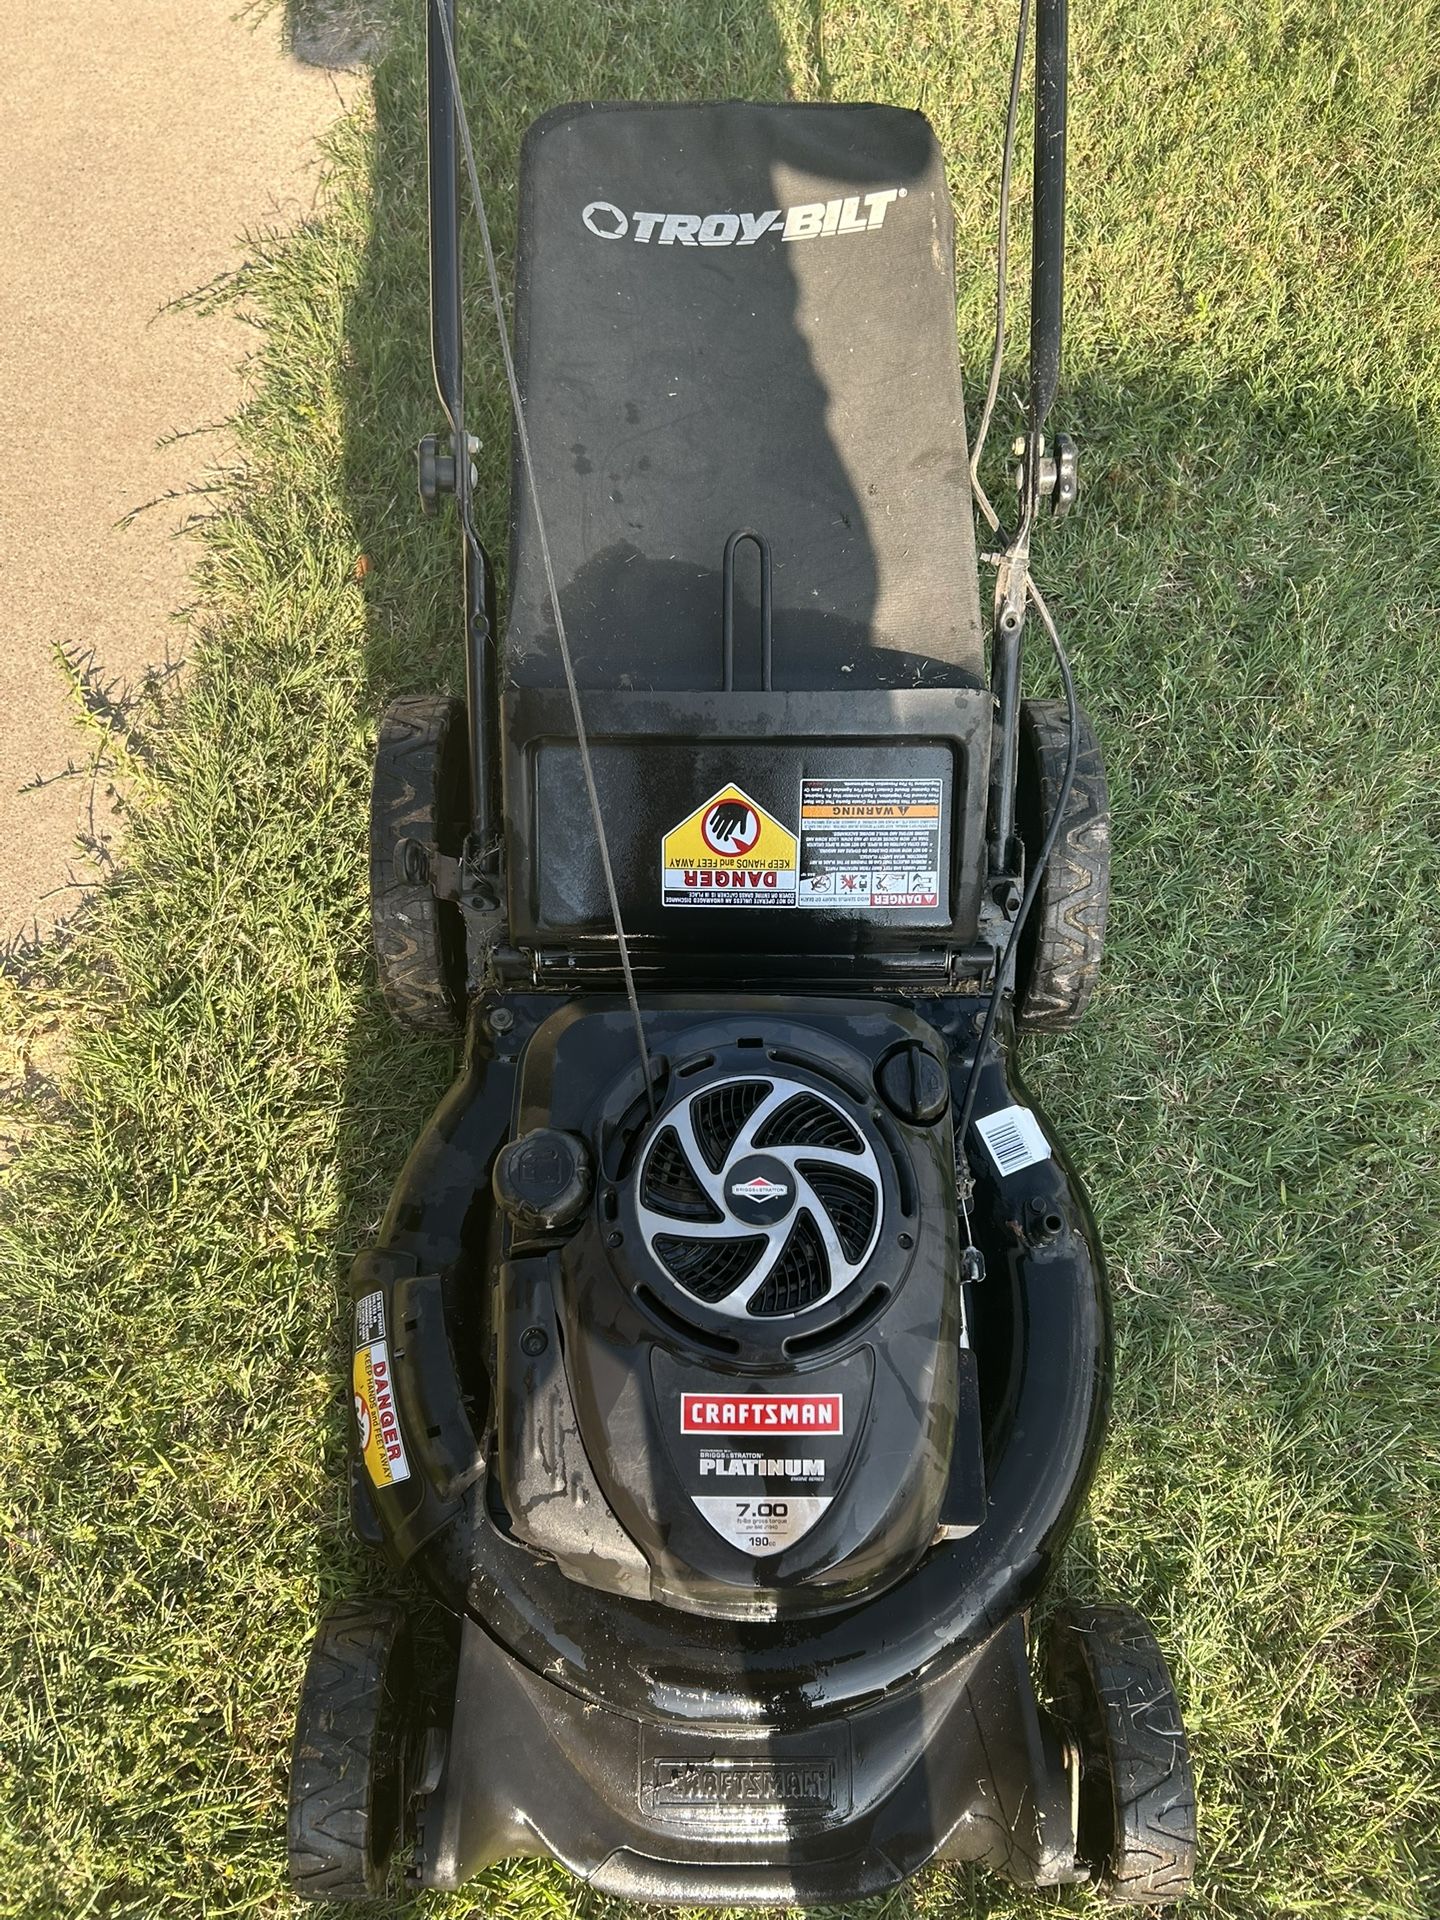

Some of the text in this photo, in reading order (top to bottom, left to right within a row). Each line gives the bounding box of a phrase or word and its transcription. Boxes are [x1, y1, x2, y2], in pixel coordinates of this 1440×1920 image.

[832, 807, 893, 815] WARNING
[669, 858, 790, 868] KEEP HANDS and FEET AWAY
[684, 871, 777, 887] DANGER
[874, 895, 922, 904] DANGER
[364, 1353, 373, 1377] KEEP
[367, 1378, 376, 1409] HANDS
[372, 1361, 401, 1462] DANGER
[691, 1403, 832, 1425] CRAFTSMAN
[374, 1429, 385, 1451] FEET
[379, 1452, 392, 1479] AWAY
[700, 1459, 825, 1476] PLATINUM
[736, 1503, 788, 1517] 7.00
